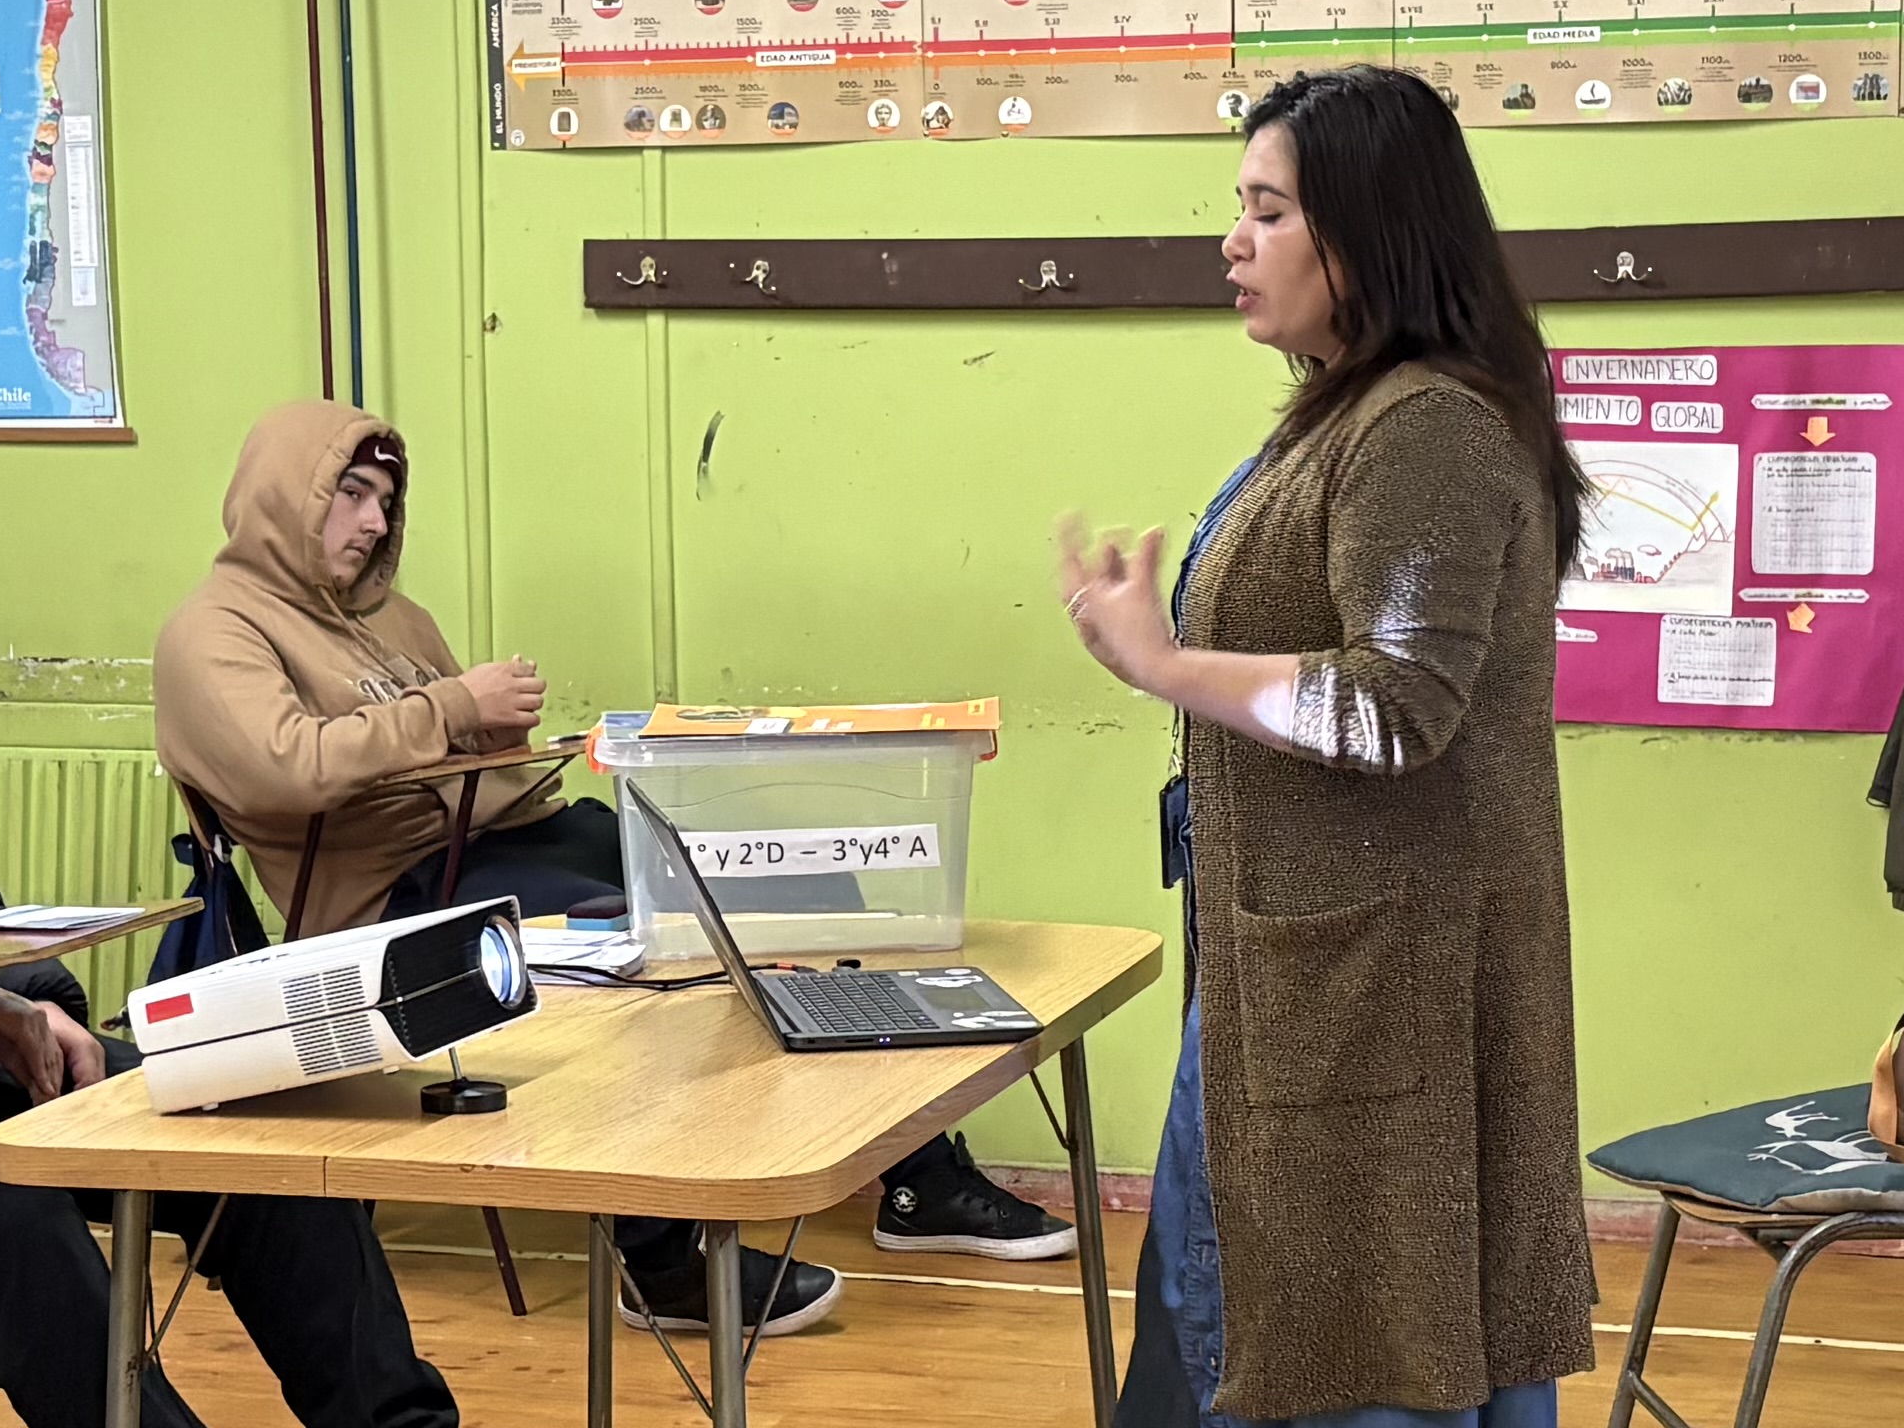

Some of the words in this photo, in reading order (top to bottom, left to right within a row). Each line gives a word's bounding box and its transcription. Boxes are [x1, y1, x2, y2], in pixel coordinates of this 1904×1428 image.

[1533, 31, 1558, 40] EDAD
[1562, 30, 1595, 39] MEDIA
[760, 54, 786, 63] EDAD
[1565, 359, 1714, 380] INVERNADERO
[1655, 404, 1721, 429] GLOBAL
[716, 848, 730, 871] y
[909, 835, 927, 858] A
